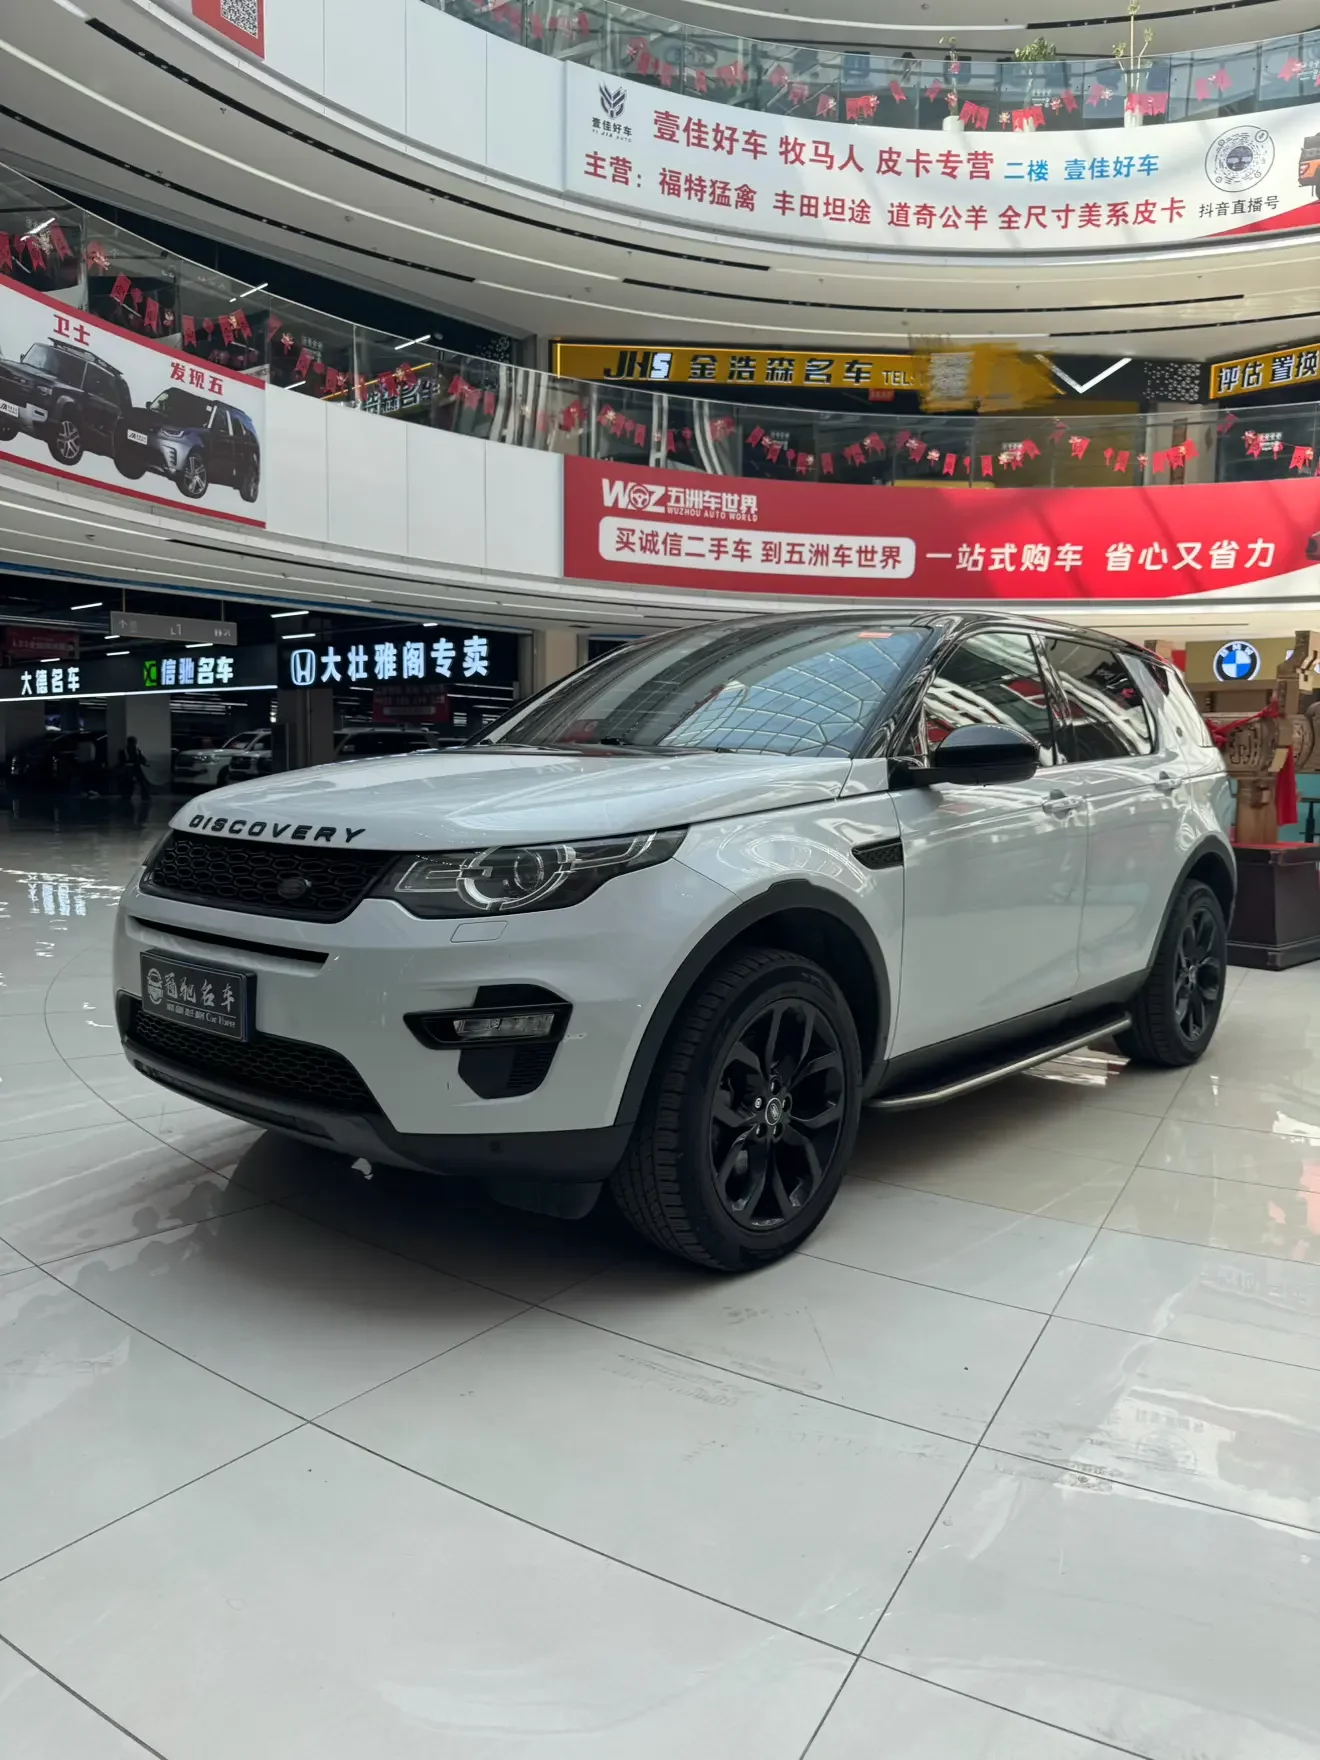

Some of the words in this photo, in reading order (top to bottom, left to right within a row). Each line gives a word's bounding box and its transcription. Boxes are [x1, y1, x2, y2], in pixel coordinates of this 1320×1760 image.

[591, 116, 633, 137] 壹佳好车
[653, 110, 768, 160] 壹佳好车
[779, 136, 865, 173] 牧马人
[877, 148, 995, 181] 皮卡专营
[1004, 159, 1049, 183] 二楼
[1064, 153, 1160, 182] 壹佳好车
[659, 167, 757, 212] 福特猛禽
[773, 190, 872, 225] 丰田坦途
[888, 200, 988, 231] 道奇公羊
[999, 197, 1187, 231] 全尺寸美系皮卡
[1199, 195, 1280, 218] 抖音直播号
[53, 314, 90, 347] 卫士
[170, 361, 224, 396] 发现五
[688, 354, 873, 386] 金浩森名车
[1217, 361, 1264, 393] 评估
[1269, 350, 1320, 384] 置换
[667, 486, 758, 515] 五洲车世界
[667, 507, 701, 517] WUZHOU
[704, 510, 726, 520] AUTO
[729, 512, 758, 523] WORLD
[615, 527, 753, 562] 买诚信二手车
[761, 540, 902, 570] 到五洲车世界
[925, 542, 1084, 573] 一站式购车
[1104, 537, 1276, 572] 省心又省力
[161, 656, 234, 686] 信驰名车
[320, 634, 490, 683] 大壮雅阁专卖
[21, 667, 81, 696] 大德名车
[188, 814, 367, 844] DISCOVERY
